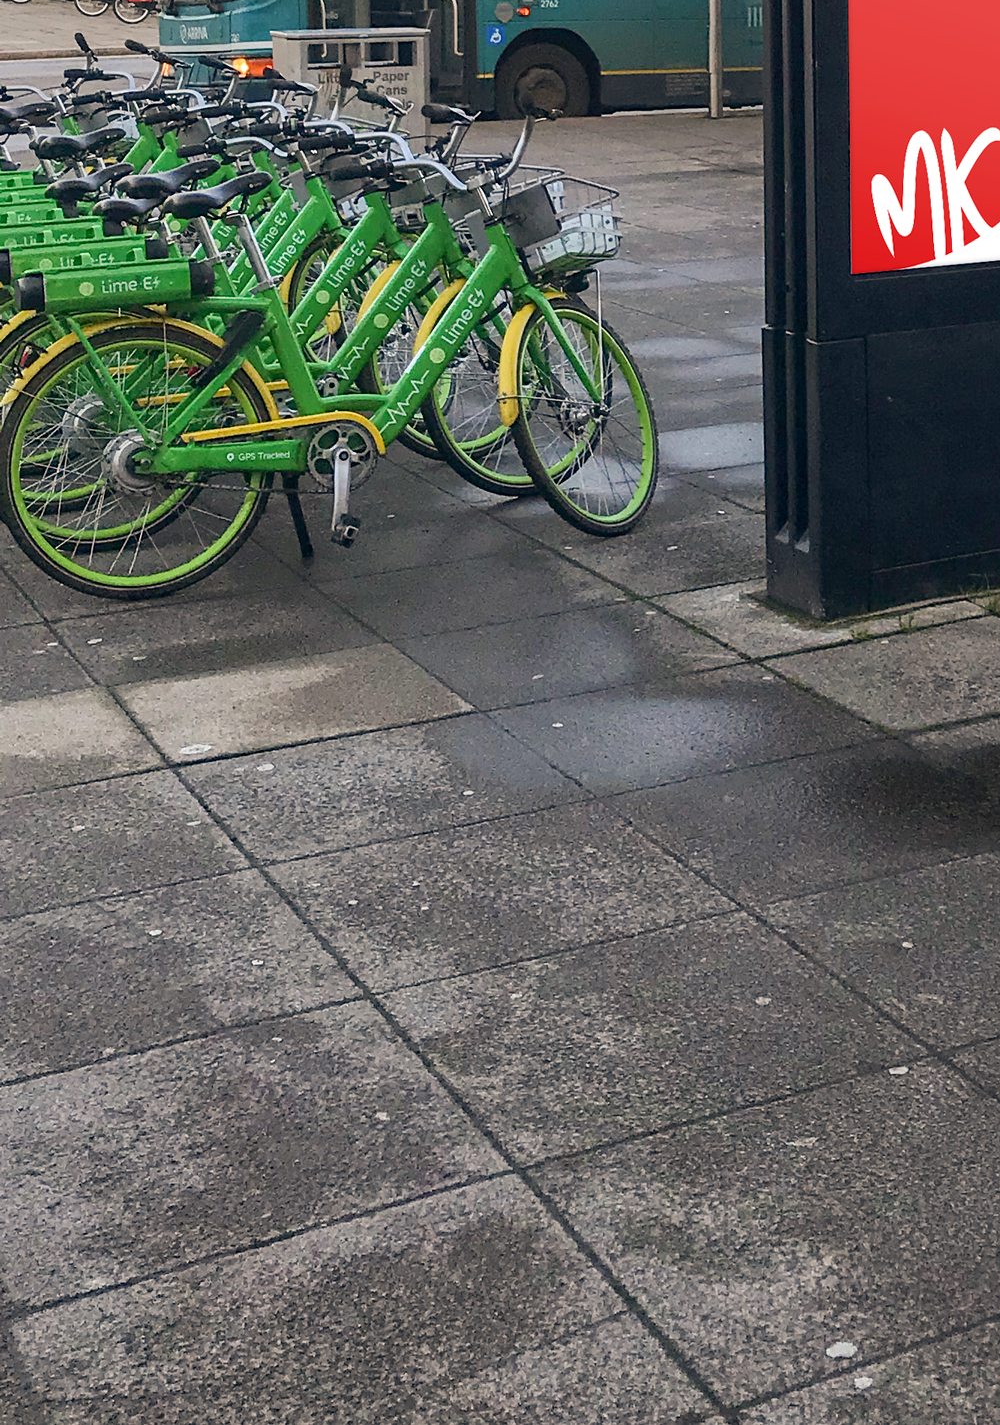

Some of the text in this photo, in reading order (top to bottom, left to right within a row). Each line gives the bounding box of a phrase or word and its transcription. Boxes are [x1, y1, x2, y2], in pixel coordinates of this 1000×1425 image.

[540, 0, 559, 8] 2762
[373, 71, 409, 84] Paper
[238, 450, 291, 462] GPS Tracked
